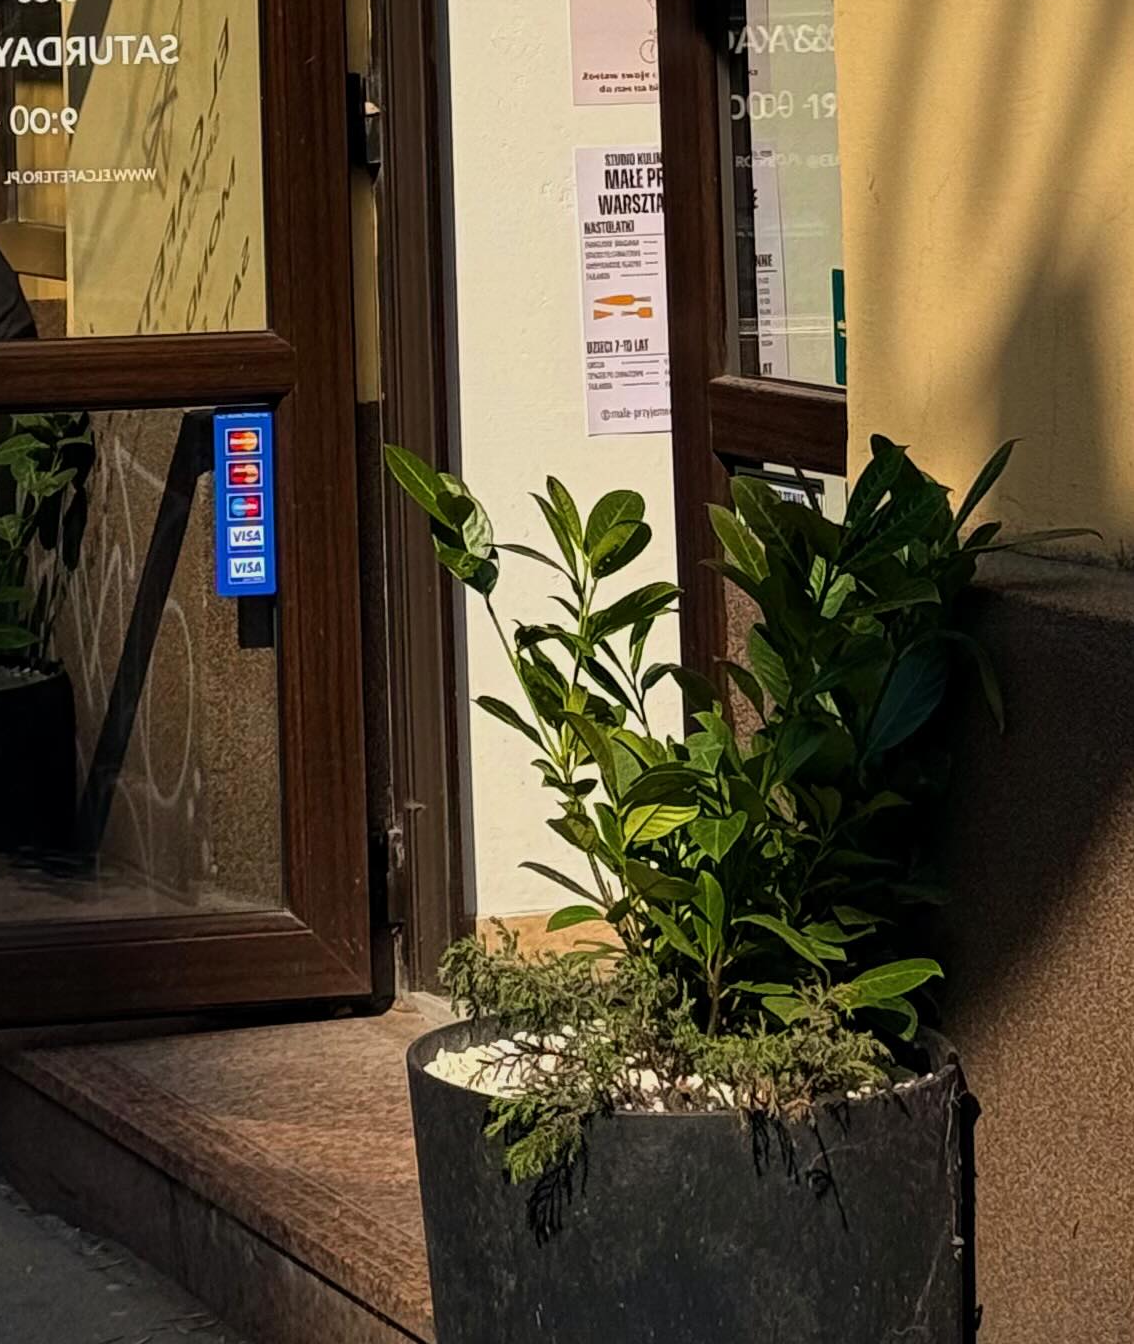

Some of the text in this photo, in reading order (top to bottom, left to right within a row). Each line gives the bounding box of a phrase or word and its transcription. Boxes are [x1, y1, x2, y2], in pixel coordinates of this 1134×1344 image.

[605, 153, 635, 166] STUDIO
[604, 169, 643, 189] MAŁE
[584, 220, 635, 234] NASTOLATKI
[634, 338, 649, 352] LAT
[233, 530, 262, 543] VISA
[234, 561, 263, 574] VISA
